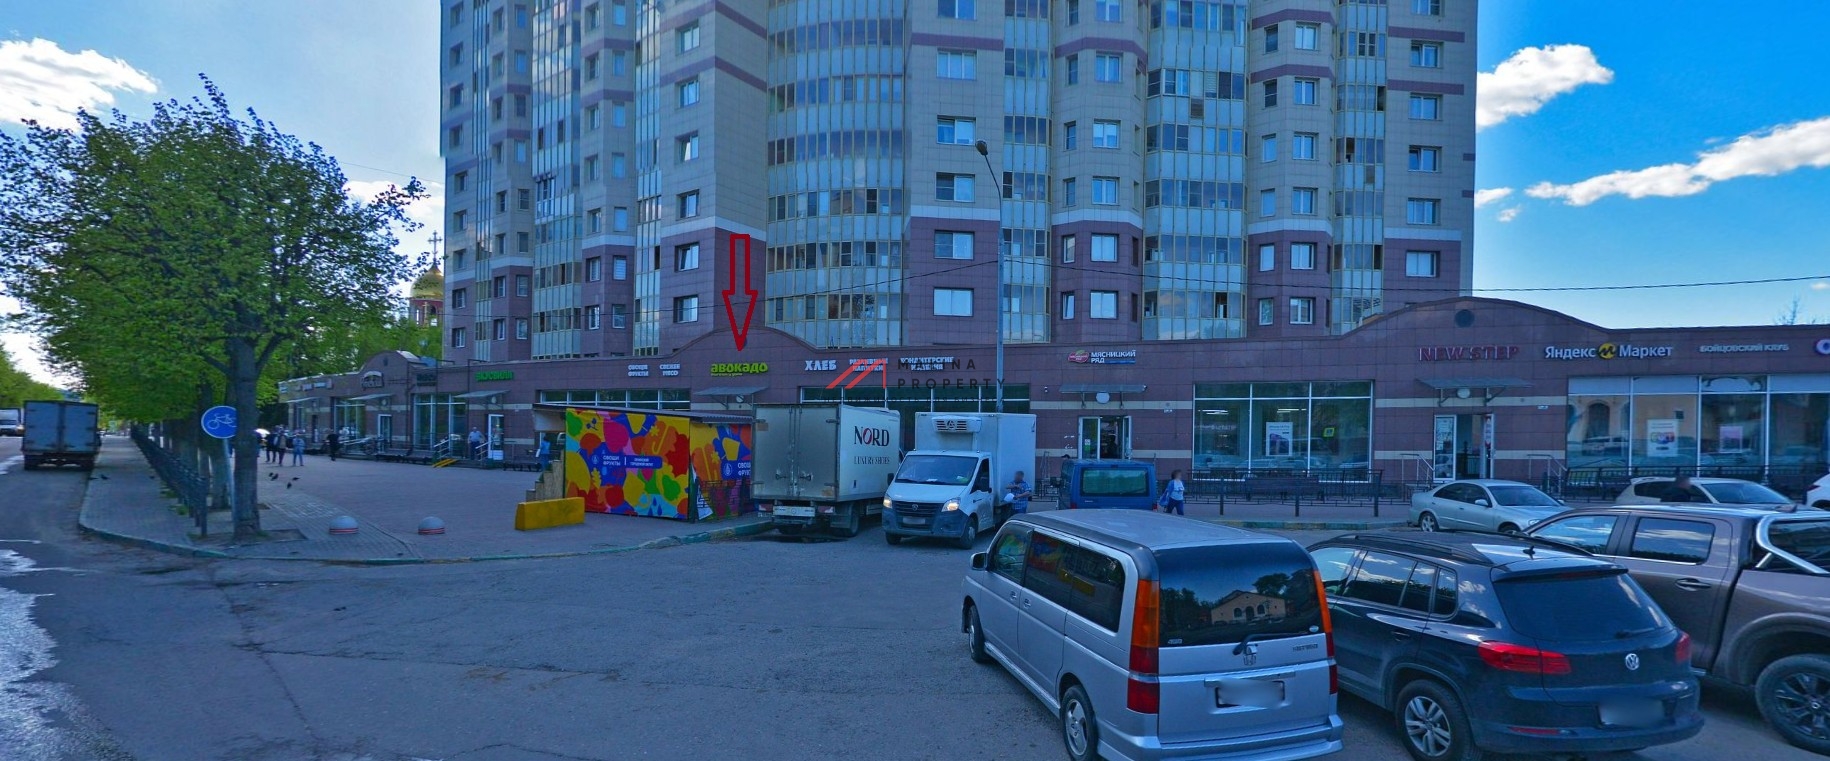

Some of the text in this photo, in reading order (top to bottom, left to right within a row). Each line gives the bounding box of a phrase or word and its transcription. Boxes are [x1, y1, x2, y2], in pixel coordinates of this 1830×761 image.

[1419, 345, 1519, 361] NEW STEP
[1545, 346, 1596, 359] Яндекс
[1619, 344, 1674, 358] Маркет
[710, 362, 768, 373] авокадо
[805, 360, 837, 370] ХЛЕБ
[854, 425, 890, 446] NORD
